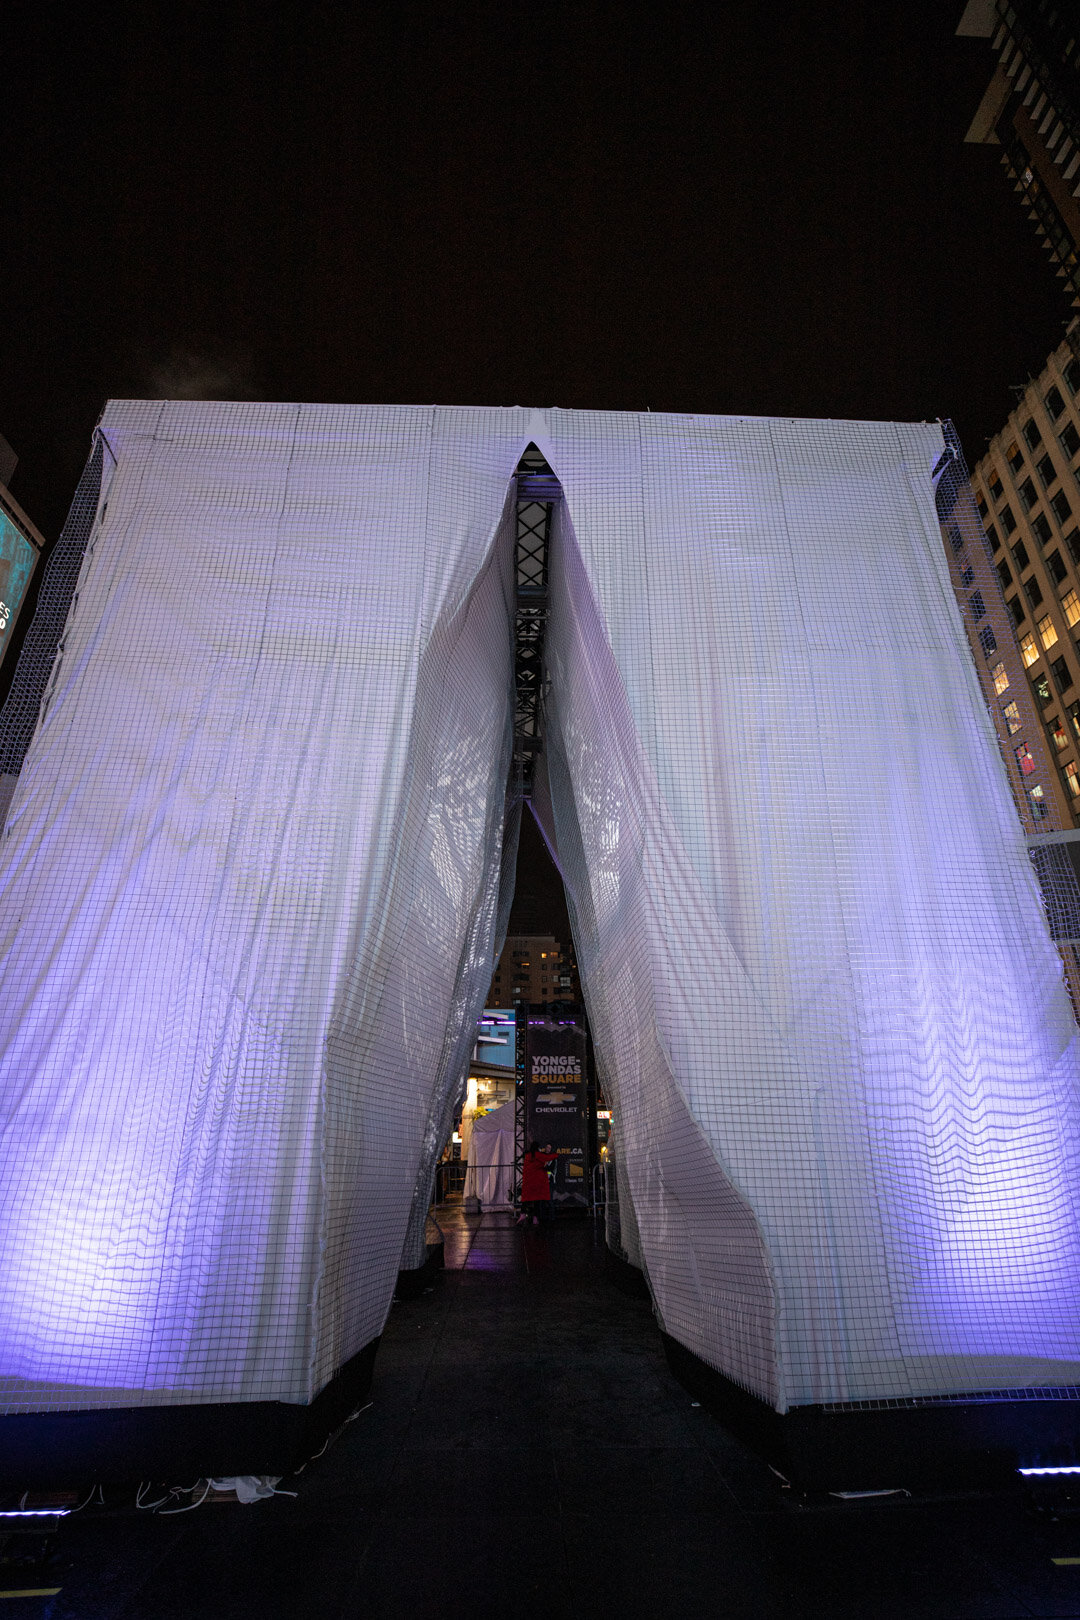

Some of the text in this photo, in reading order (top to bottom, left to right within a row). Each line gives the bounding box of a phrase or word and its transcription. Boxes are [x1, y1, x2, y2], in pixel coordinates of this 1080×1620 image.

[532, 1055, 580, 1066] YONGE-
[531, 1065, 581, 1075] DUNDAS
[531, 1074, 581, 1084] SQUARE
